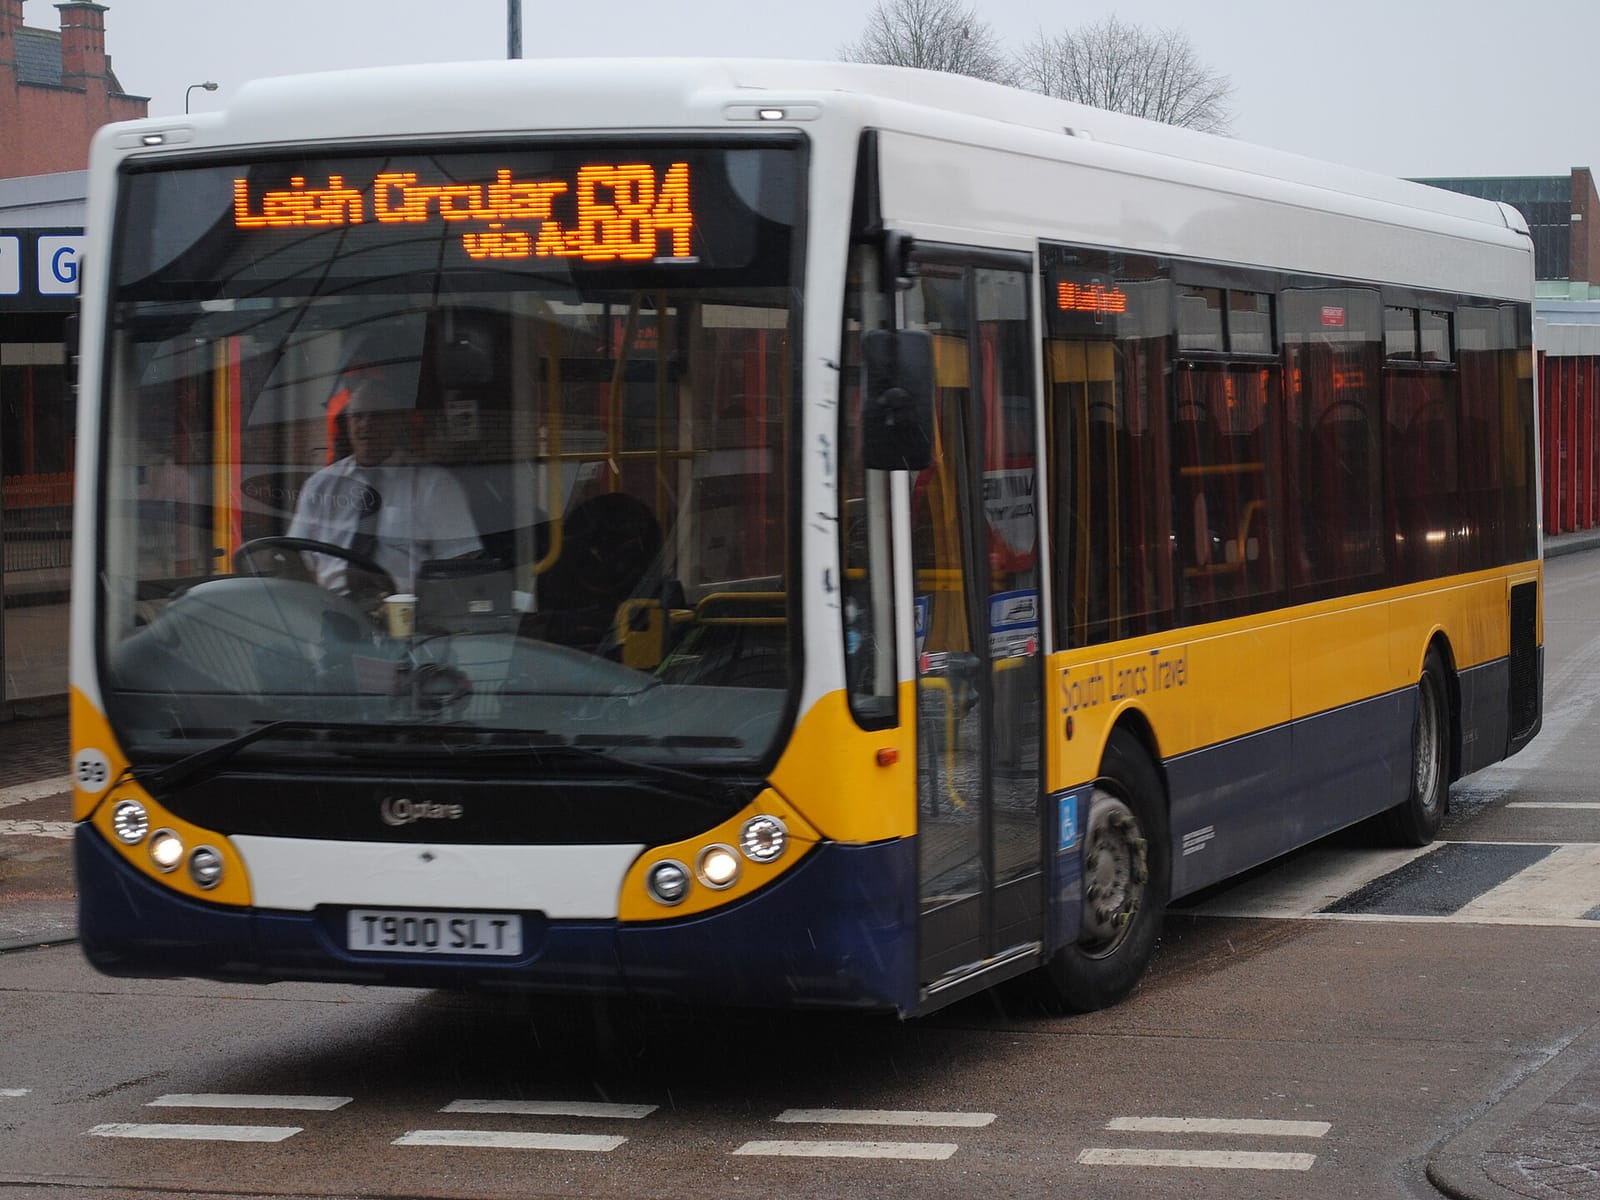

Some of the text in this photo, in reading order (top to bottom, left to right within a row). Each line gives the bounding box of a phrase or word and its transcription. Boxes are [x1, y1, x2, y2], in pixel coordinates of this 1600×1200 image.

[234, 169, 568, 228] Leigh Circular
[576, 162, 693, 261] 684
[463, 222, 531, 258] via
[51, 246, 78, 284] G
[1061, 644, 1188, 713] South Lancs Travel
[79, 761, 105, 783] 59
[391, 798, 464, 824] Optare
[361, 915, 510, 950] T900 SLT
